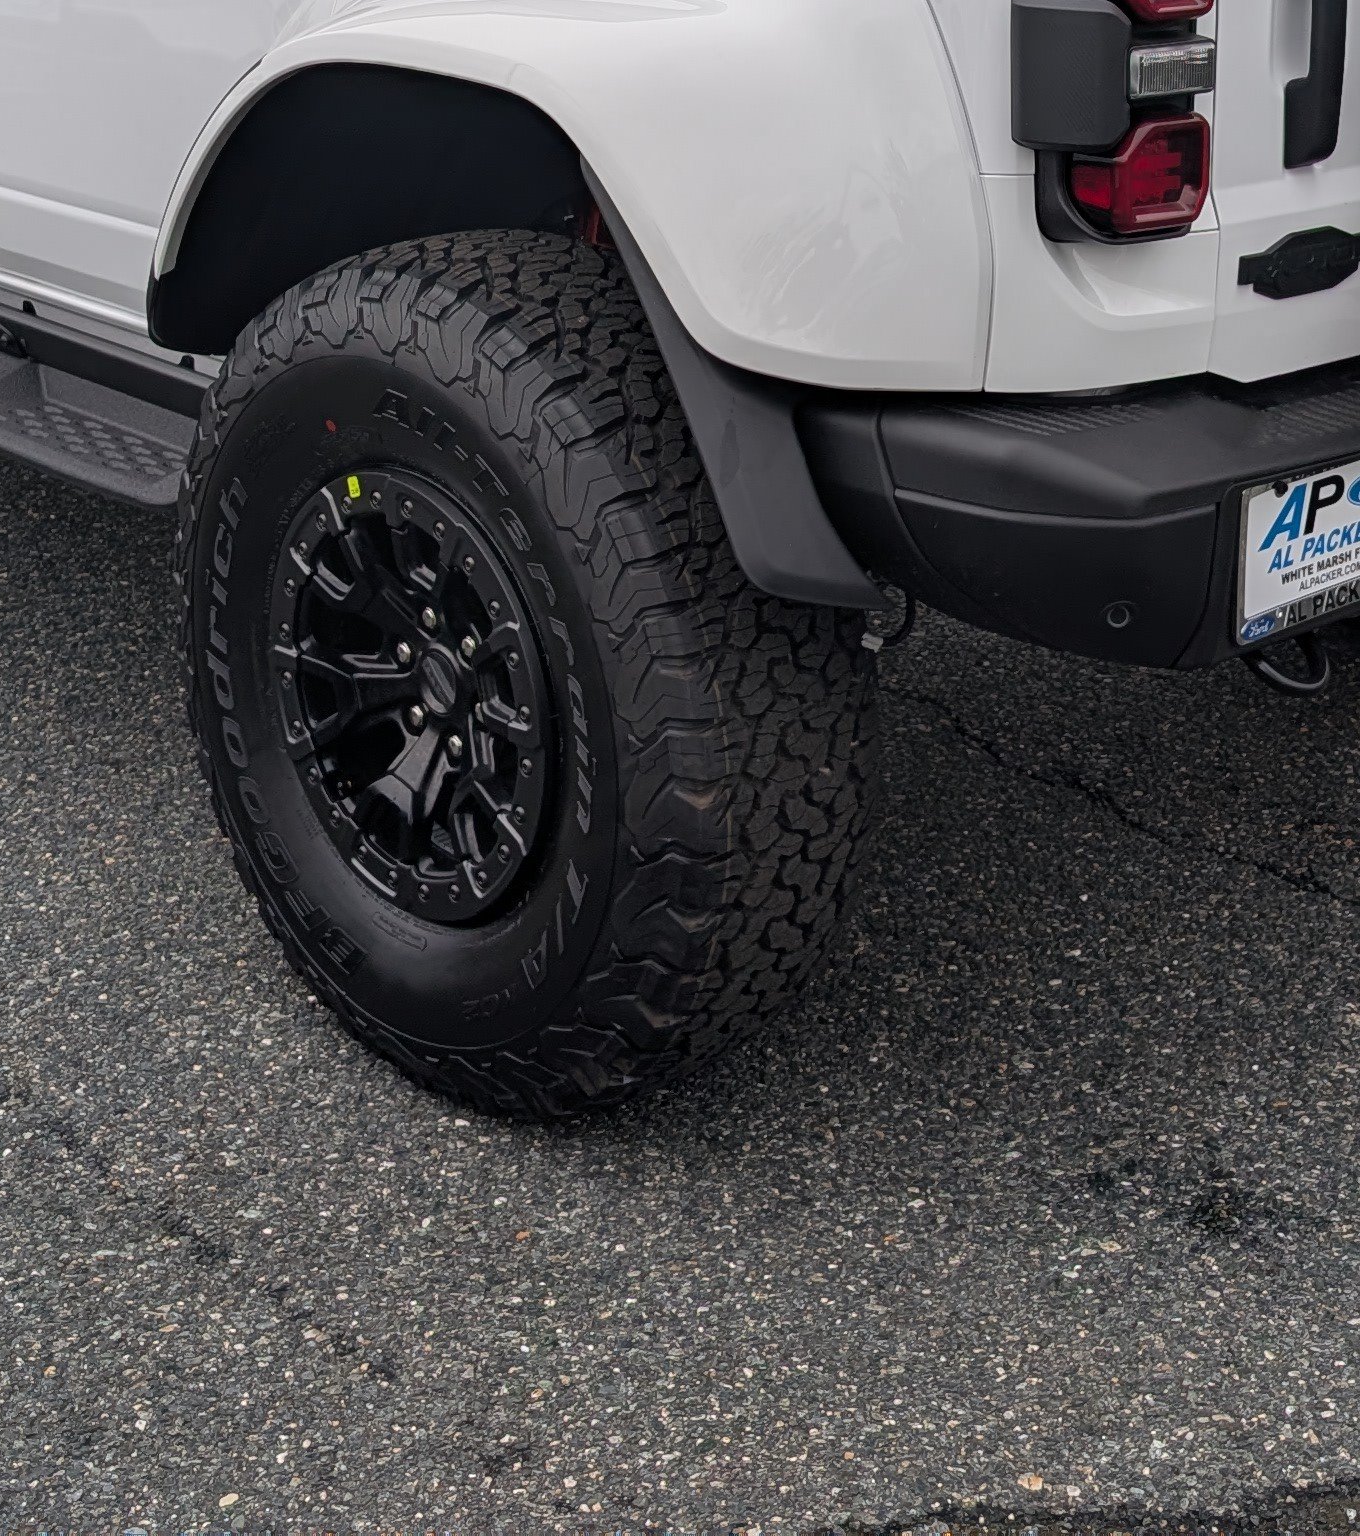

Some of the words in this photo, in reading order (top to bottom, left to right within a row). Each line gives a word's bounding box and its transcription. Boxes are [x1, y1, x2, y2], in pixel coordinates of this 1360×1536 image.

[1257, 474, 1345, 552] AP
[1267, 544, 1294, 574] AL
[1281, 564, 1314, 585] WHITE
[1316, 550, 1352, 572] MARSH
[1285, 602, 1307, 627] AL
[204, 473, 368, 977] BFGoodrich
